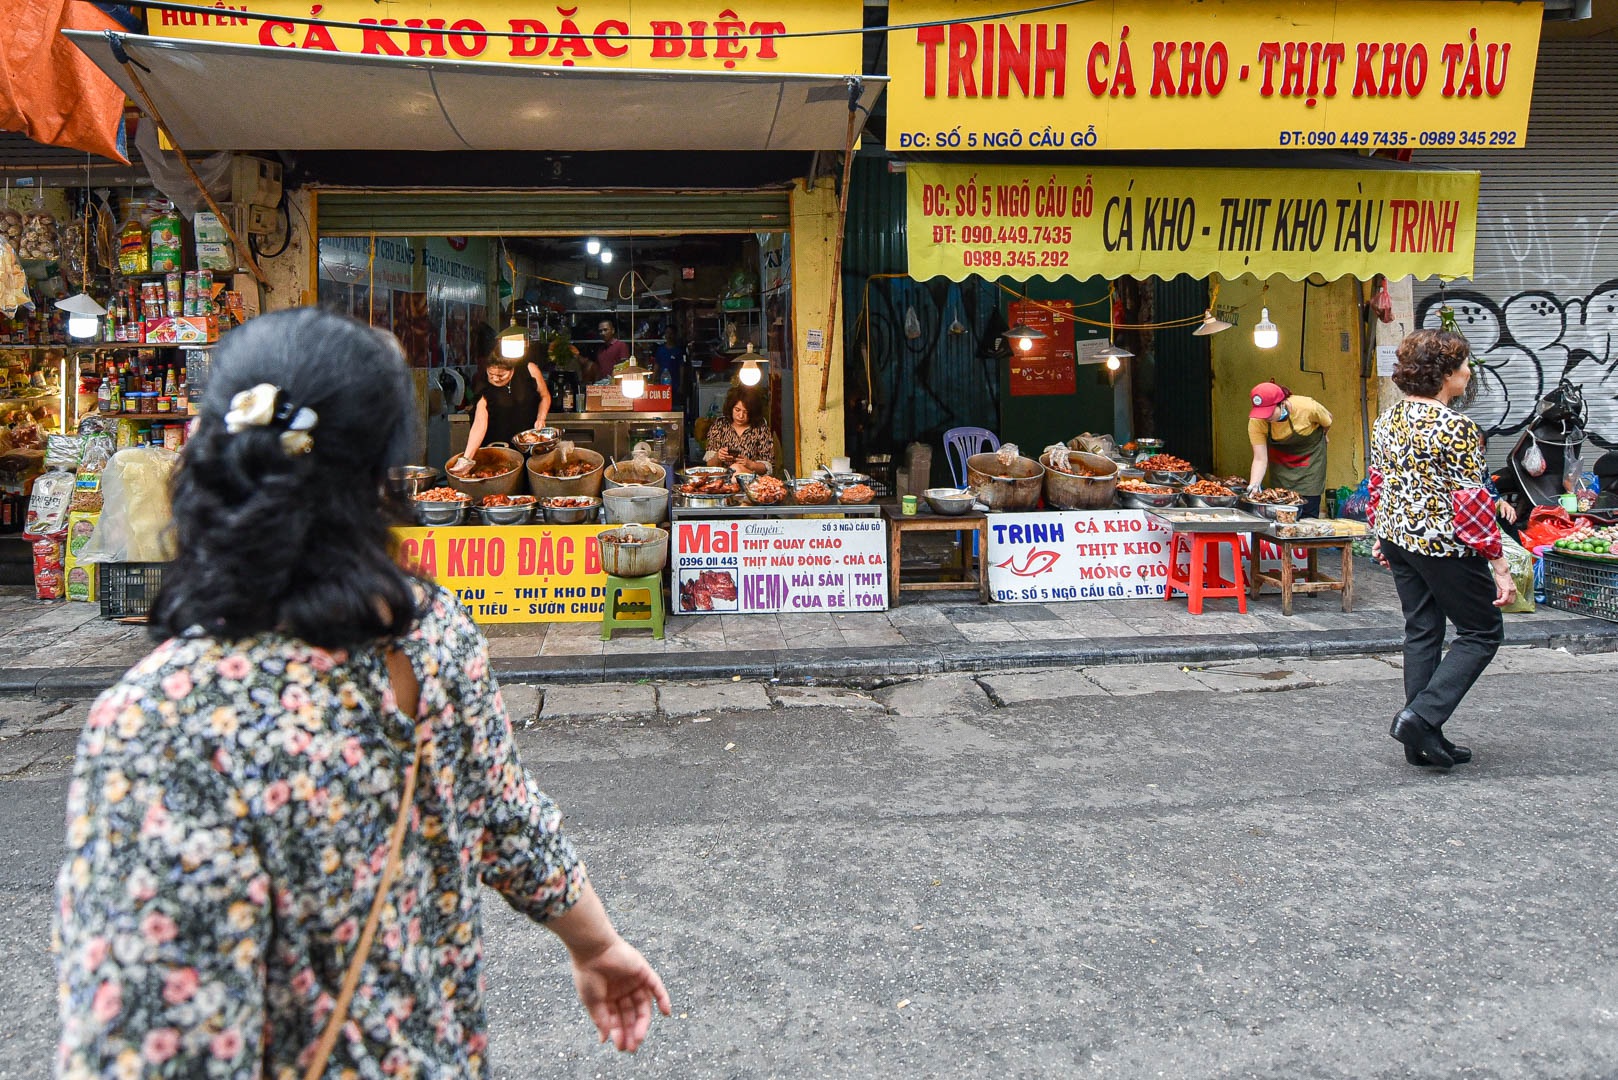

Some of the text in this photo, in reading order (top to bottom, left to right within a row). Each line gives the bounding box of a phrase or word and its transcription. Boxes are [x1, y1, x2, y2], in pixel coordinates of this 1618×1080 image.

[258, 4, 786, 69] CÁ KHO ĐẶC BIỆT
[917, 22, 1067, 98] TRINH
[1086, 25, 1511, 107] CÁ KHO - THỊT KHO TÀU
[899, 124, 1098, 147] ĐC: SỐ 5 NGÕ CẦU GỖ
[1340, 131, 1369, 146] 449
[1372, 131, 1408, 146] 7435
[1419, 131, 1455, 146] 0989
[1459, 131, 1486, 146] 345
[1489, 131, 1517, 146] 292
[923, 173, 1094, 217] ĐC: SỐ 5 NGÕ CẦU GỖ
[1102, 179, 1384, 265] CÁ KHO - THỊT KHO TÀU
[1389, 199, 1460, 253] TRINH
[932, 225, 1072, 244] ĐT: 090.449.7435
[963, 250, 1069, 267] 0989.345.292
[833, 523, 837, 531] 3
[993, 523, 1065, 544] TRINH
[1074, 517, 1100, 534] CÁ
[1104, 519, 1142, 533] KHO
[679, 522, 738, 554] Mai
[743, 539, 769, 552] THỊT
[773, 539, 805, 550] QUAY
[400, 531, 437, 577] CÁ
[447, 537, 506, 577] KHO
[518, 531, 574, 583] ĐẶC
[1076, 542, 1118, 559] THỊT
[1123, 541, 1162, 555] KHO
[680, 557, 703, 566] 0396
[721, 557, 738, 566] 443
[743, 556, 767, 569] THỊT
[1079, 563, 1132, 580] MÓNG
[1136, 560, 1168, 578] GIÒ
[855, 573, 882, 589] THỊT
[514, 587, 549, 601] THỊT
[554, 587, 586, 598] KHO
[744, 574, 781, 609] NEM
[855, 591, 884, 607] TÔM
[997, 589, 1018, 601] ĐC:
[1021, 584, 1038, 600] SỐ
[1041, 588, 1048, 599] 5
[1051, 585, 1077, 600] NGÕ
[1108, 582, 1124, 597] GỖ
[1135, 585, 1153, 595] ĐT:
[478, 602, 508, 615] TIÊU
[529, 600, 566, 614] SƯỜN
[792, 595, 822, 608] CUA
